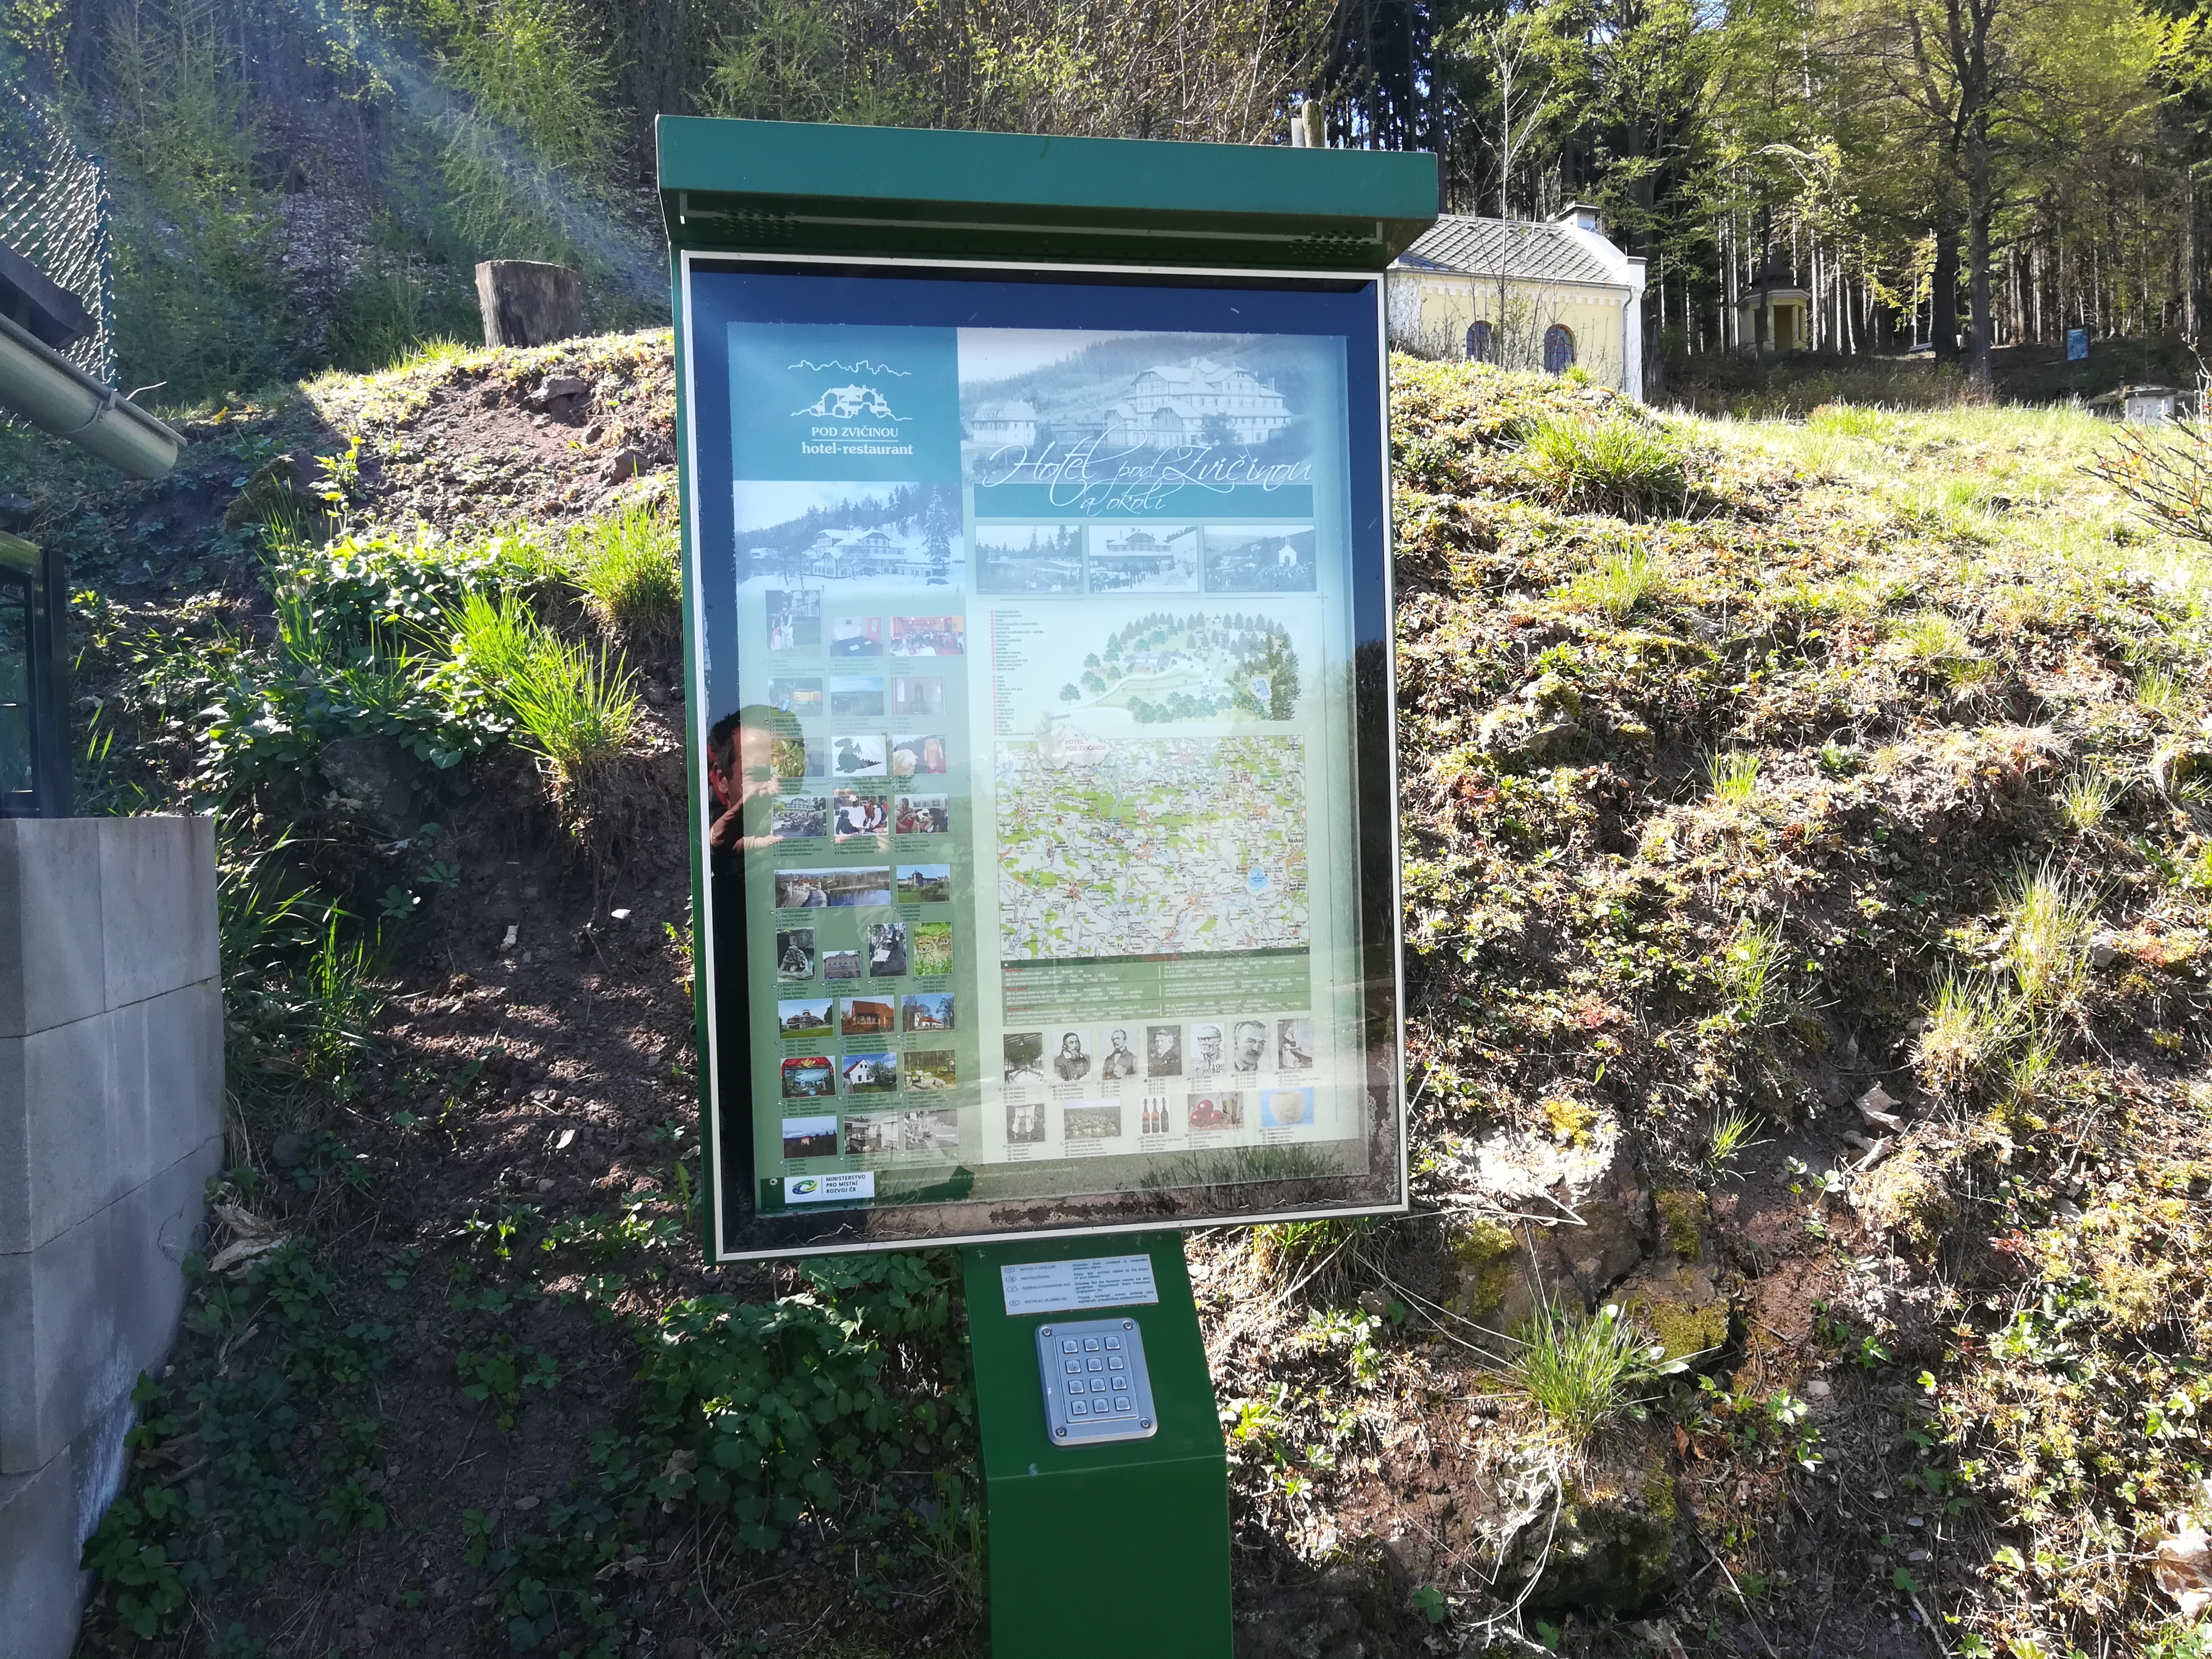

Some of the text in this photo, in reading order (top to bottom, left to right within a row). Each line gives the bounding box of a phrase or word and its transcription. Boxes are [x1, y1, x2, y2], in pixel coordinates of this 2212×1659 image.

[812, 425, 899, 438] POD ZVIČINOU
[802, 442, 914, 455] hotel-restaurant
[1163, 445, 1312, 493] Zvičinou
